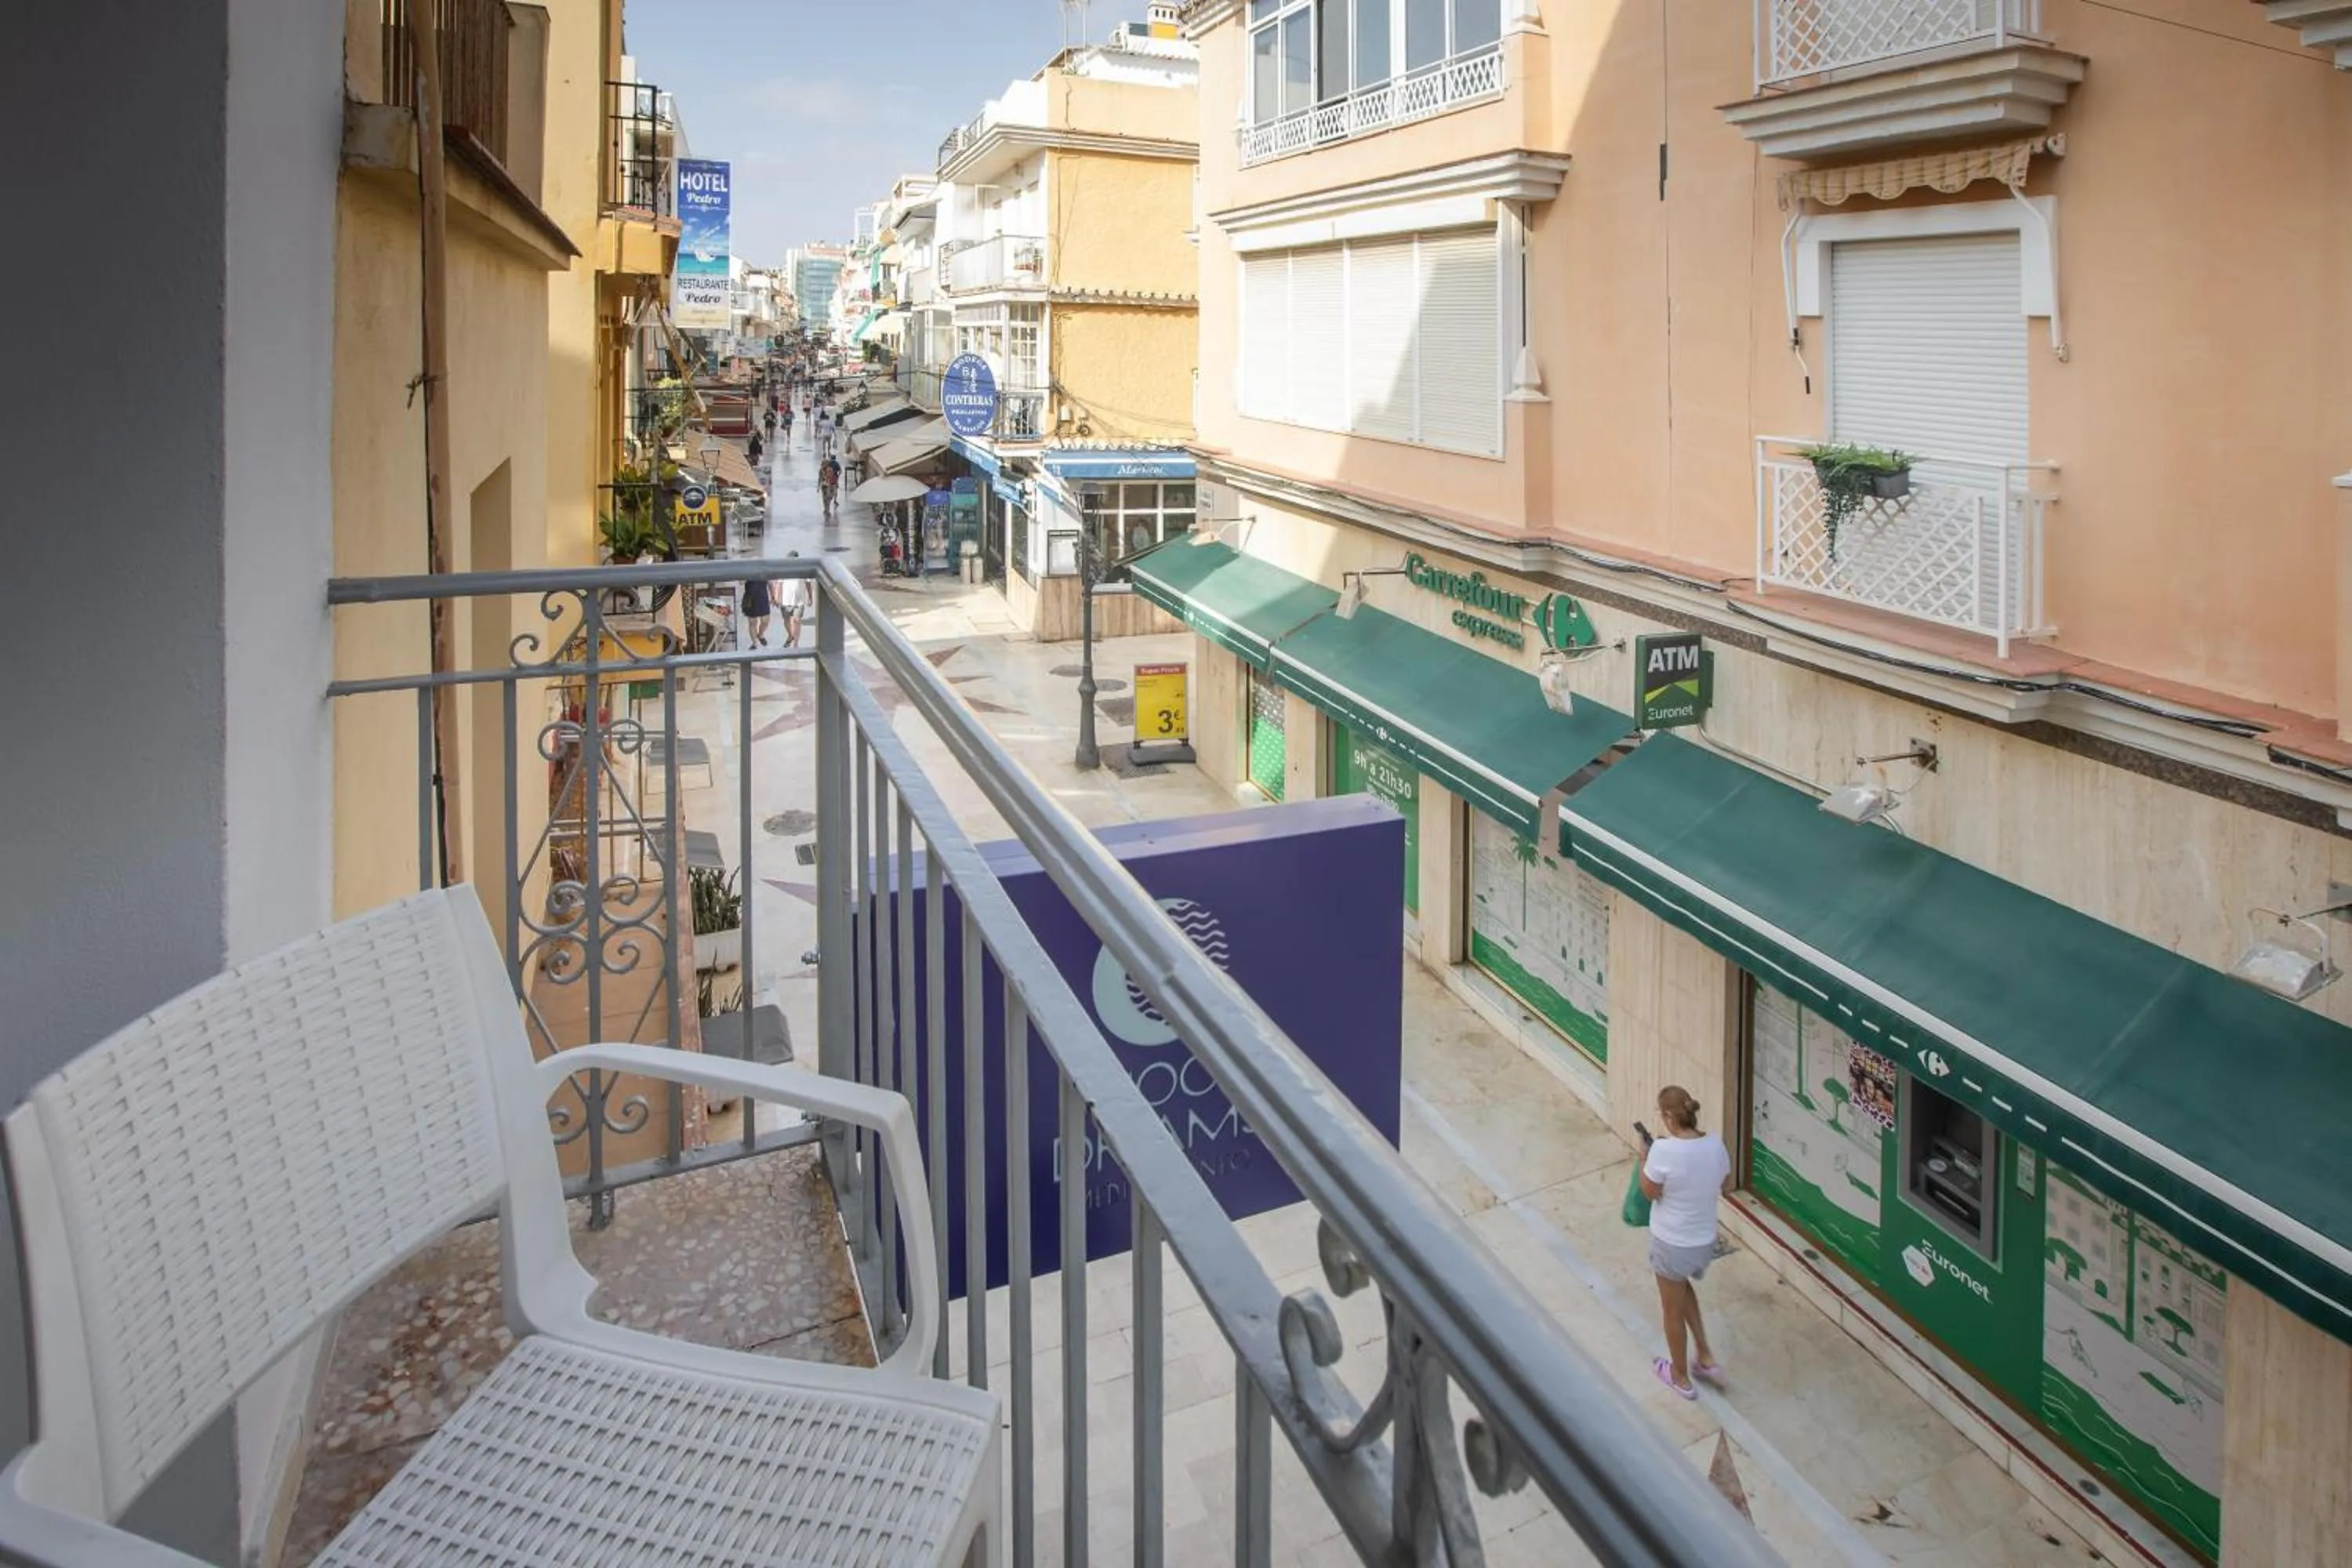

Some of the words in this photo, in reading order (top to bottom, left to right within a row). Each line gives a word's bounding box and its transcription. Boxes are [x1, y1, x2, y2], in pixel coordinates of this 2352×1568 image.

[680, 172, 728, 192] HOTEL
[686, 192, 722, 205] Pedro
[677, 277, 729, 291] RESTAURANTE
[684, 292, 721, 303] Pedro
[945, 394, 993, 405] CONTRERAS
[678, 512, 713, 524] ATM
[1406, 553, 1525, 621] Carrefour
[1452, 609, 1524, 651] express
[1647, 645, 1699, 673] ATM
[1647, 704, 1693, 720] Euronet
[1370, 762, 1376, 776] a
[1380, 766, 1412, 799] 21h30
[1921, 1238, 1994, 1305] Euronet
